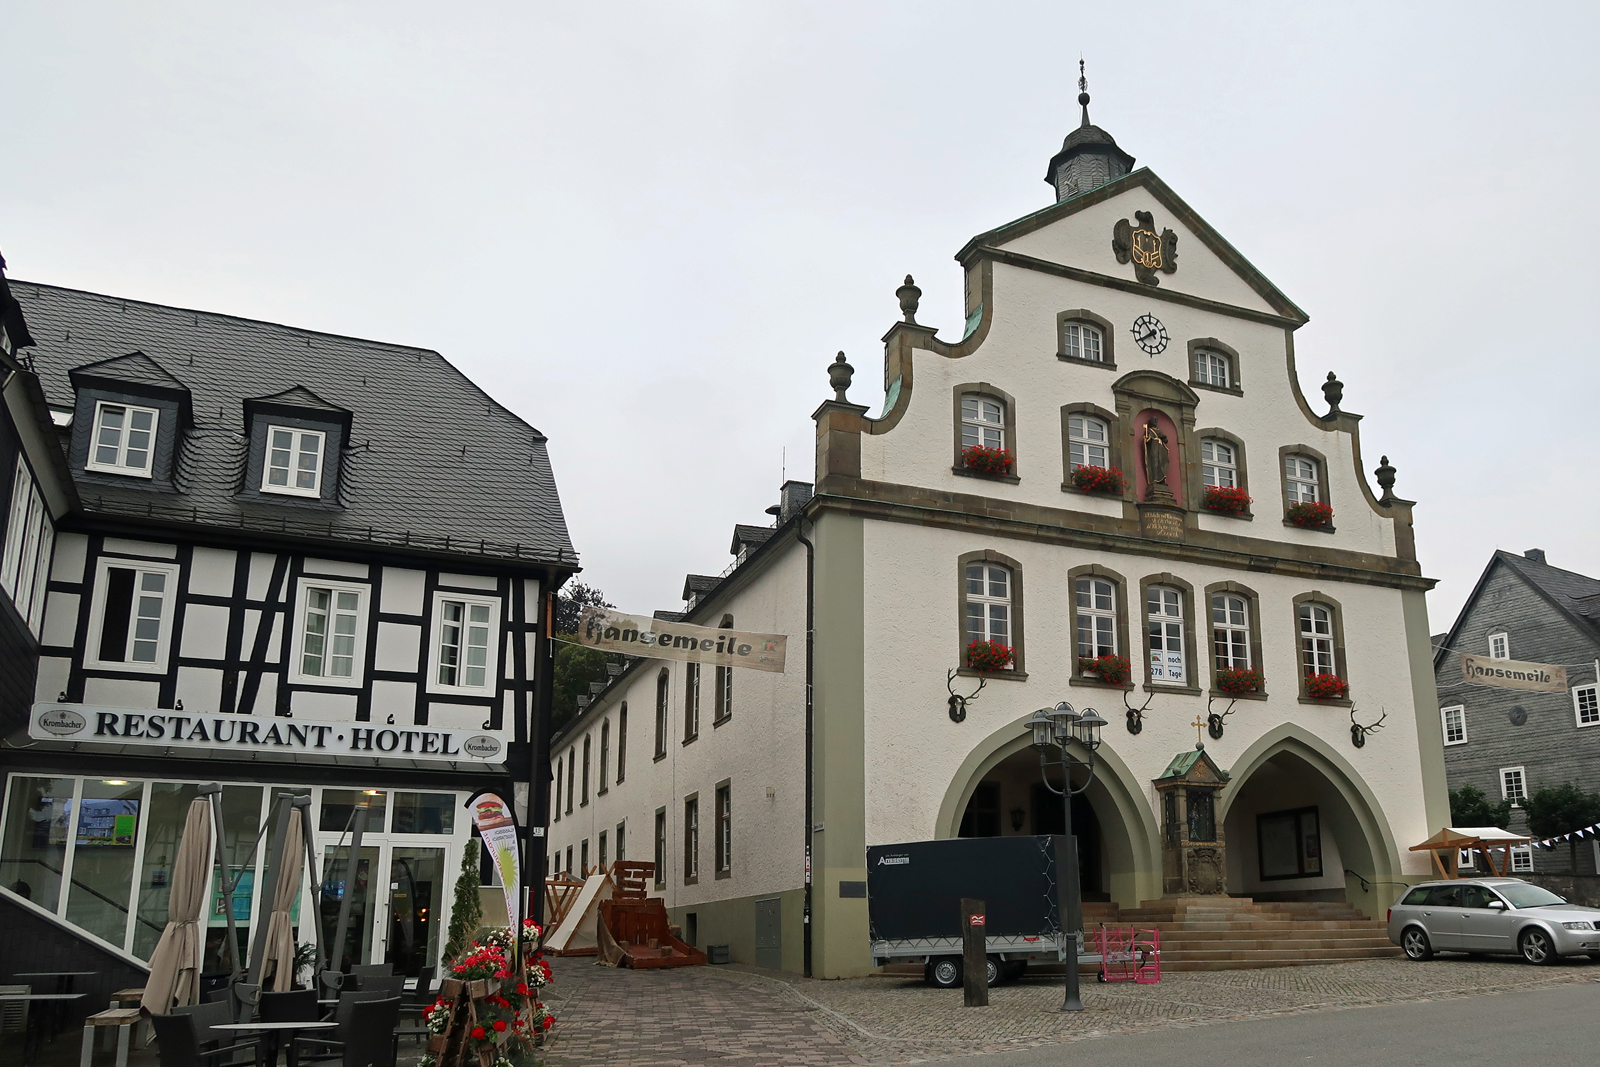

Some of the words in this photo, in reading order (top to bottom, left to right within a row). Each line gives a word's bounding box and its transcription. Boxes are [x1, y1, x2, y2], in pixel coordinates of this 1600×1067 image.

[1168, 656, 1181, 664] noch
[1151, 667, 1163, 676] 278
[1169, 669, 1182, 679] Tage
[43, 718, 83, 729] Krombacher
[94, 711, 332, 748] RESTAURANT
[350, 727, 460, 755] HOTEL
[467, 743, 498, 752] Krombacher
